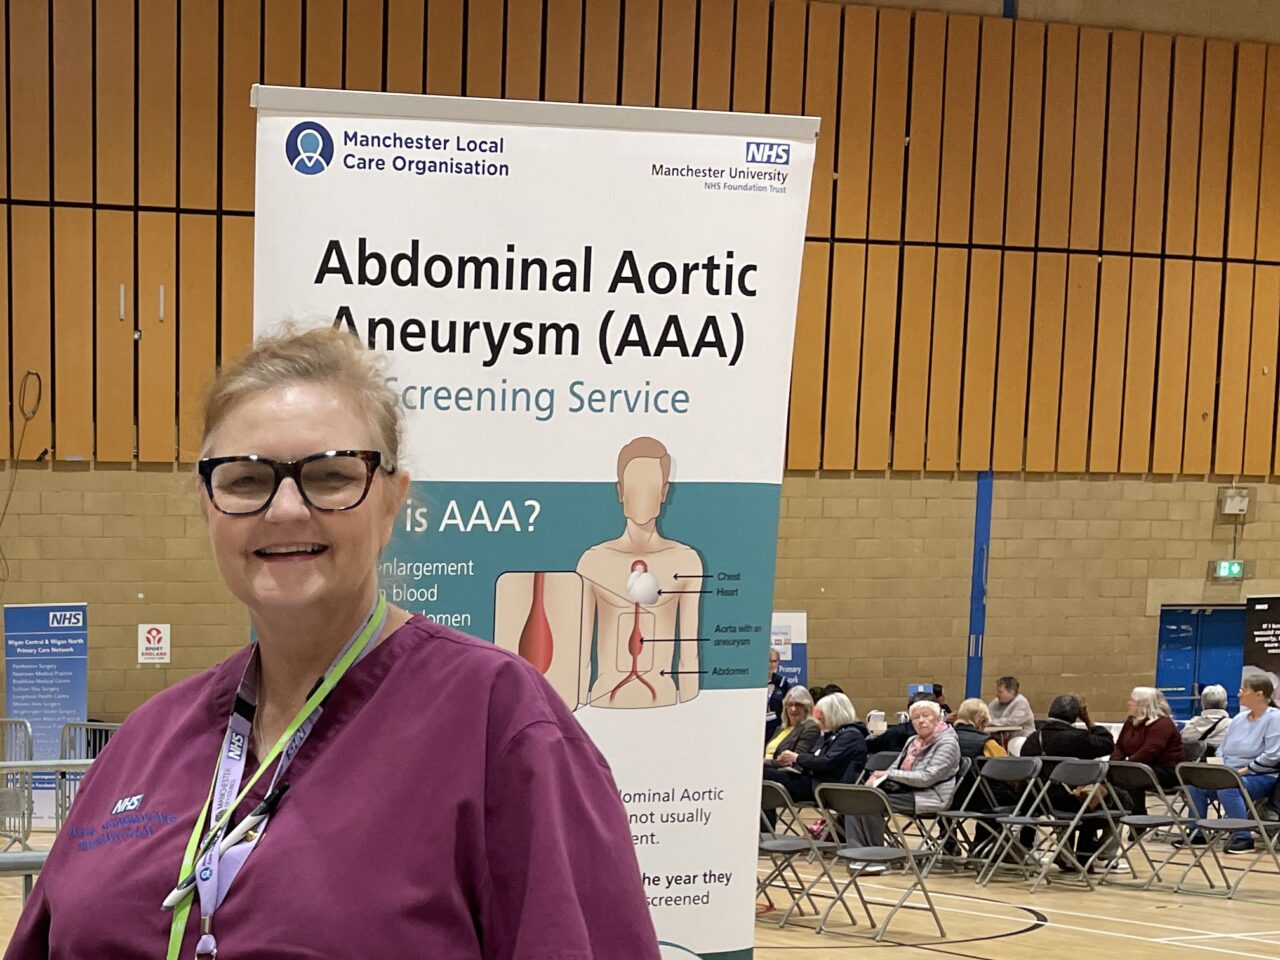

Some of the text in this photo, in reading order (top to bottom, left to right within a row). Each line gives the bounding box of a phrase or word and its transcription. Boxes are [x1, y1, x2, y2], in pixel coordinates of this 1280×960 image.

[344, 130, 504, 154] Manchester Local
[748, 142, 788, 164] NHS
[343, 153, 510, 178] Care Organisation
[652, 164, 788, 184] Manchester University
[314, 238, 758, 298] Abdominal Aortic
[598, 310, 744, 366] (AAA)
[568, 380, 690, 415] Service
[405, 500, 540, 532] is AAA?
[717, 572, 740, 581] Chest
[393, 584, 438, 601] blood
[717, 588, 738, 596] Heart
[50, 613, 81, 626] NHS
[712, 667, 749, 675] Abdomen
[779, 665, 801, 674] Primary
[228, 732, 244, 760] NHS
[112, 794, 144, 815] NHS
[619, 787, 724, 803] ominal Aortic
[629, 808, 711, 825] not usually
[642, 870, 732, 889] he year they
[646, 890, 710, 907] screened
